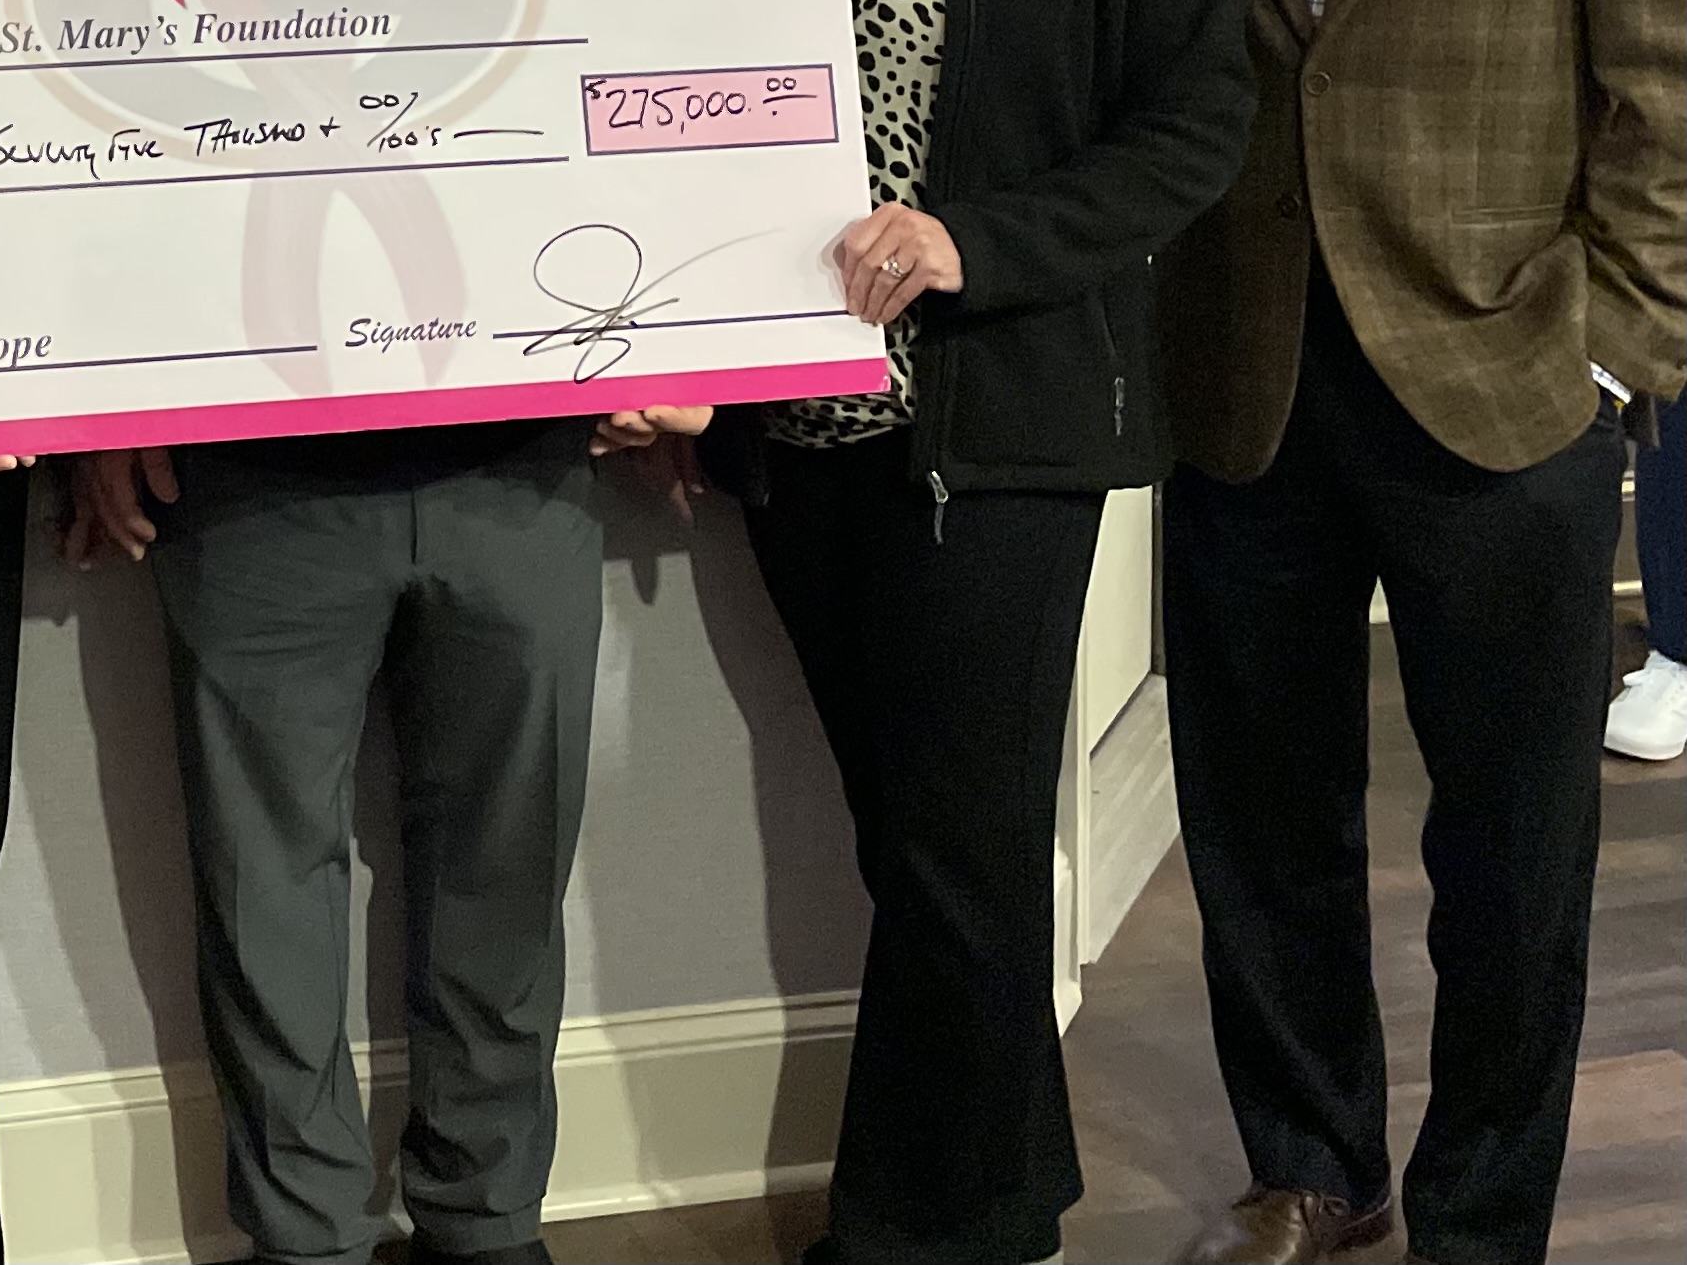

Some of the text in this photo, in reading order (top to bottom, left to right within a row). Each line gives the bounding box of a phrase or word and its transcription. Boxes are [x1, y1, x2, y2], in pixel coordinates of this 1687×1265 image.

[0, 21, 42, 54] St.
[57, 15, 178, 55] Mary's
[192, 7, 391, 45] Foundation
[345, 316, 477, 353] Signature
